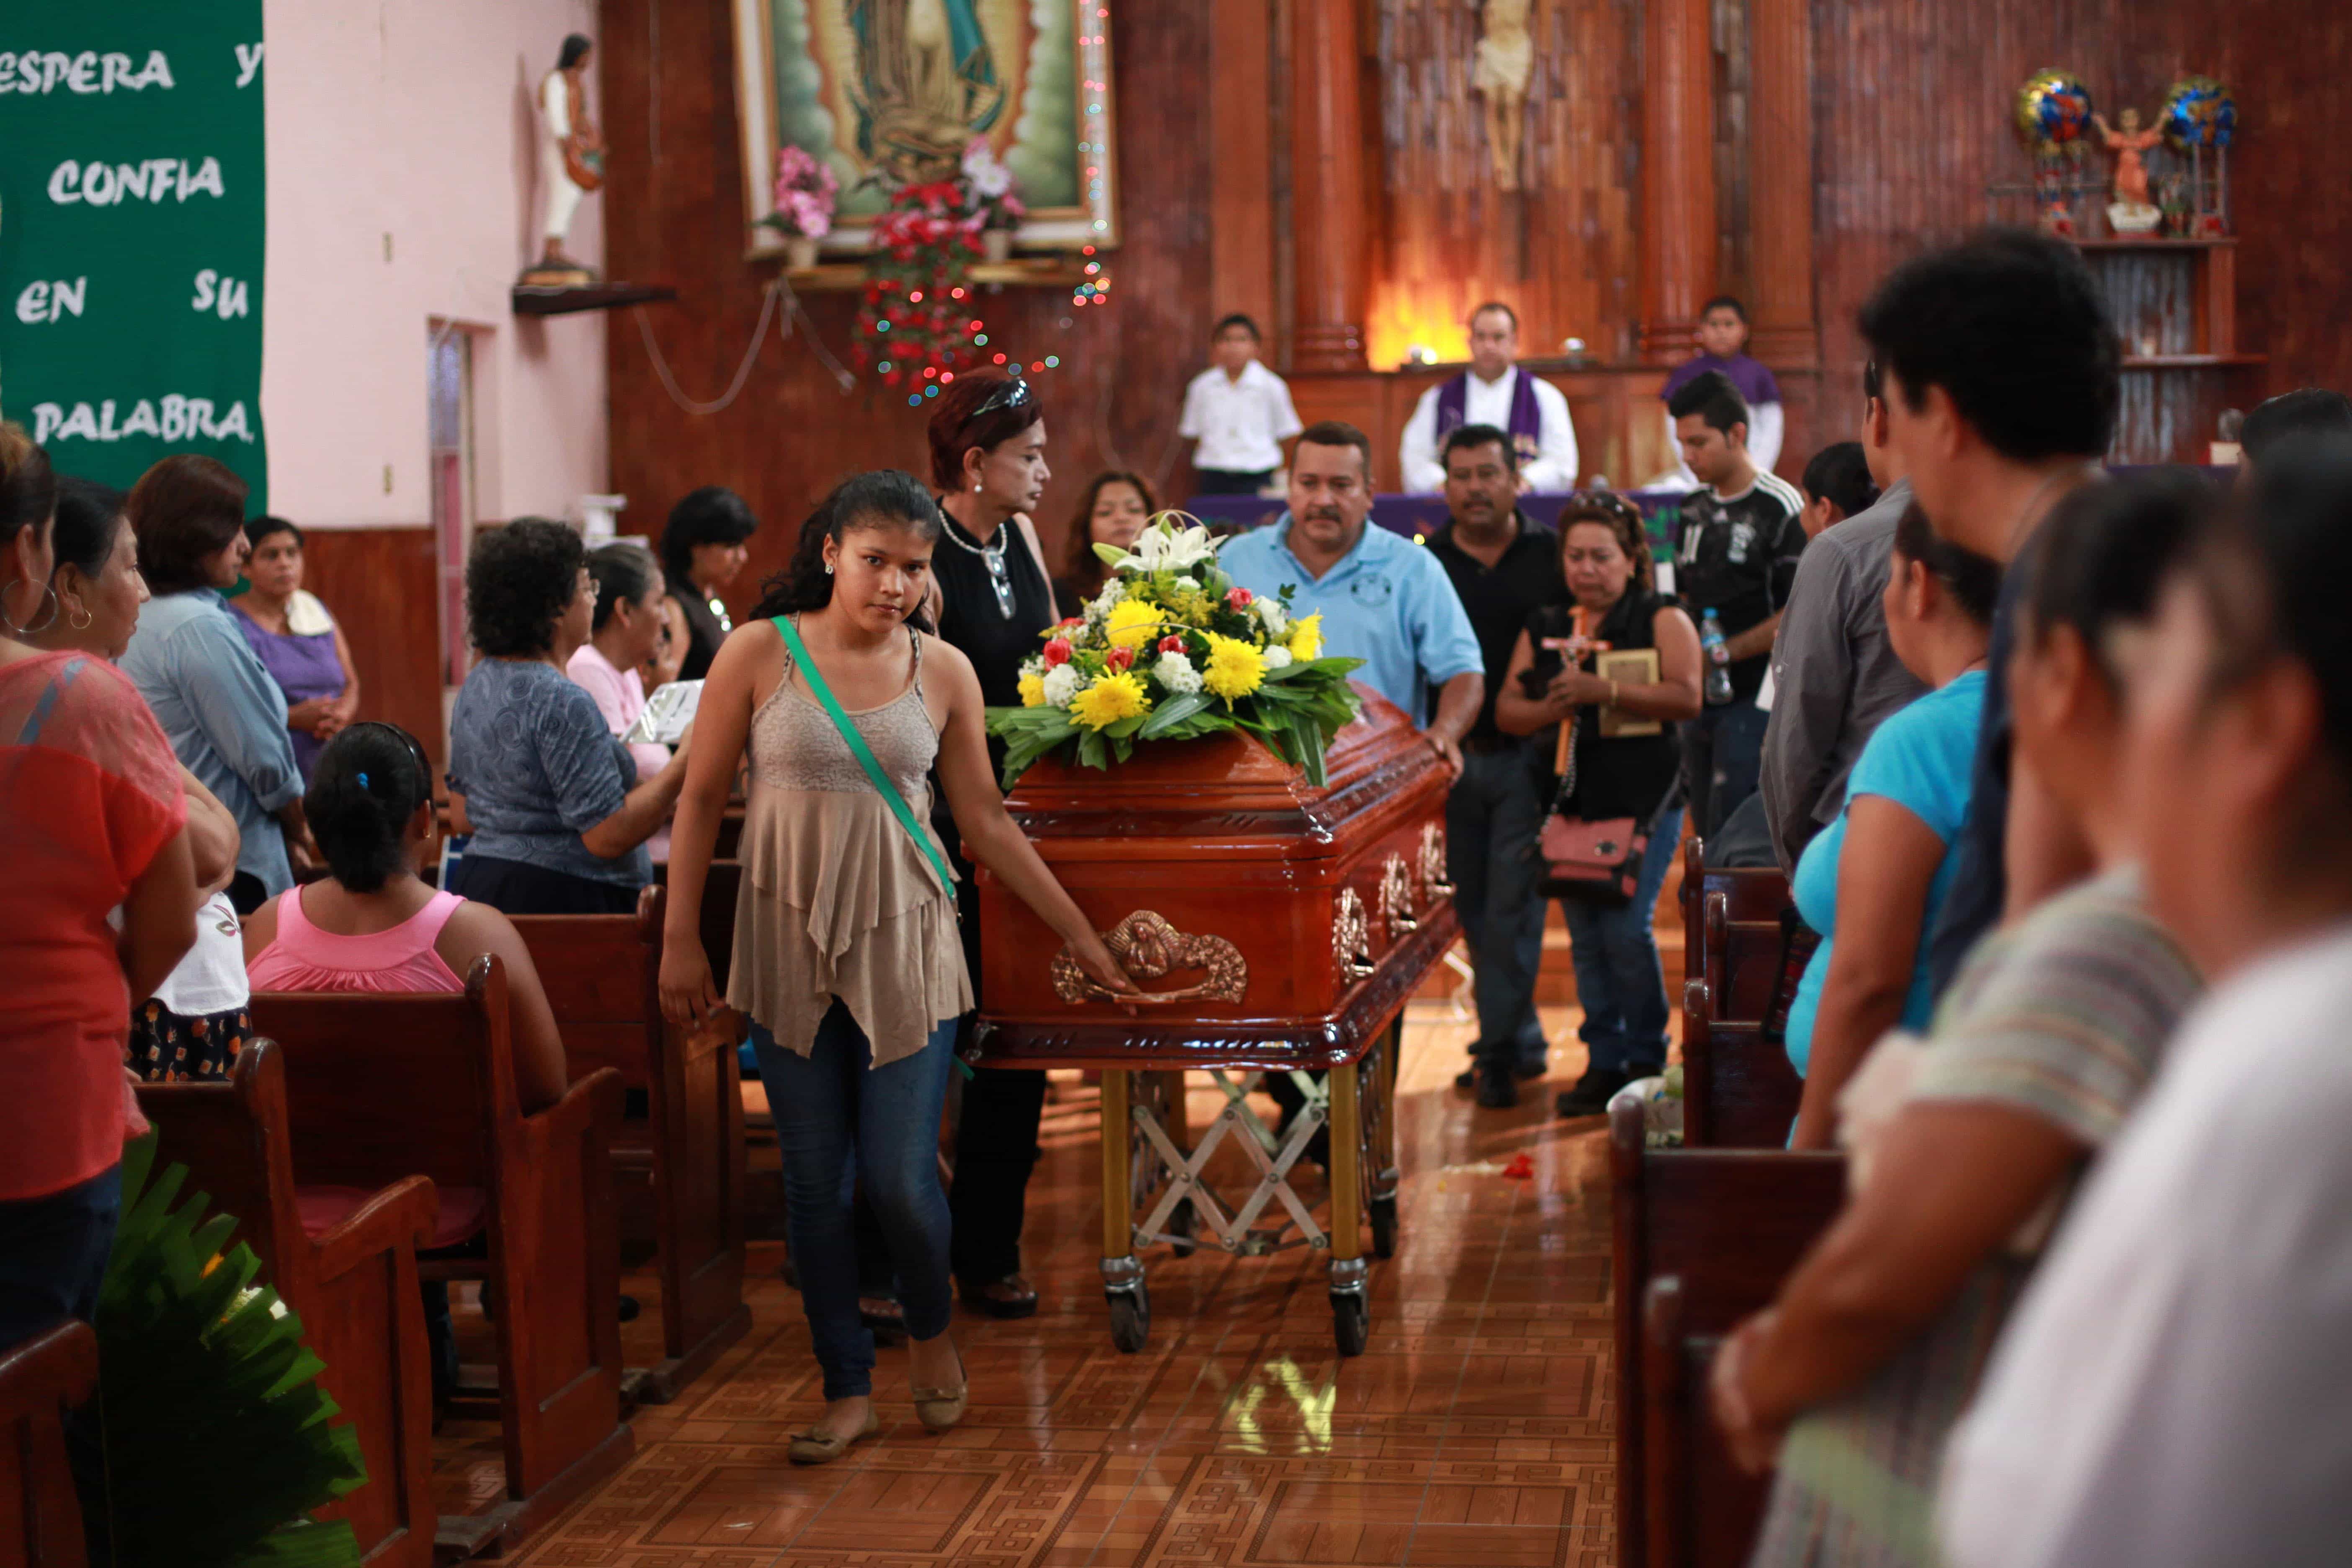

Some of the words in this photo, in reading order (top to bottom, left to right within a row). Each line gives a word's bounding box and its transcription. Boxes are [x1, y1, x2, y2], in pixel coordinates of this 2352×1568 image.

[0, 50, 174, 93] ESPERA
[47, 157, 224, 205] CONFIA
[16, 276, 86, 322] EN
[192, 269, 248, 319] SU
